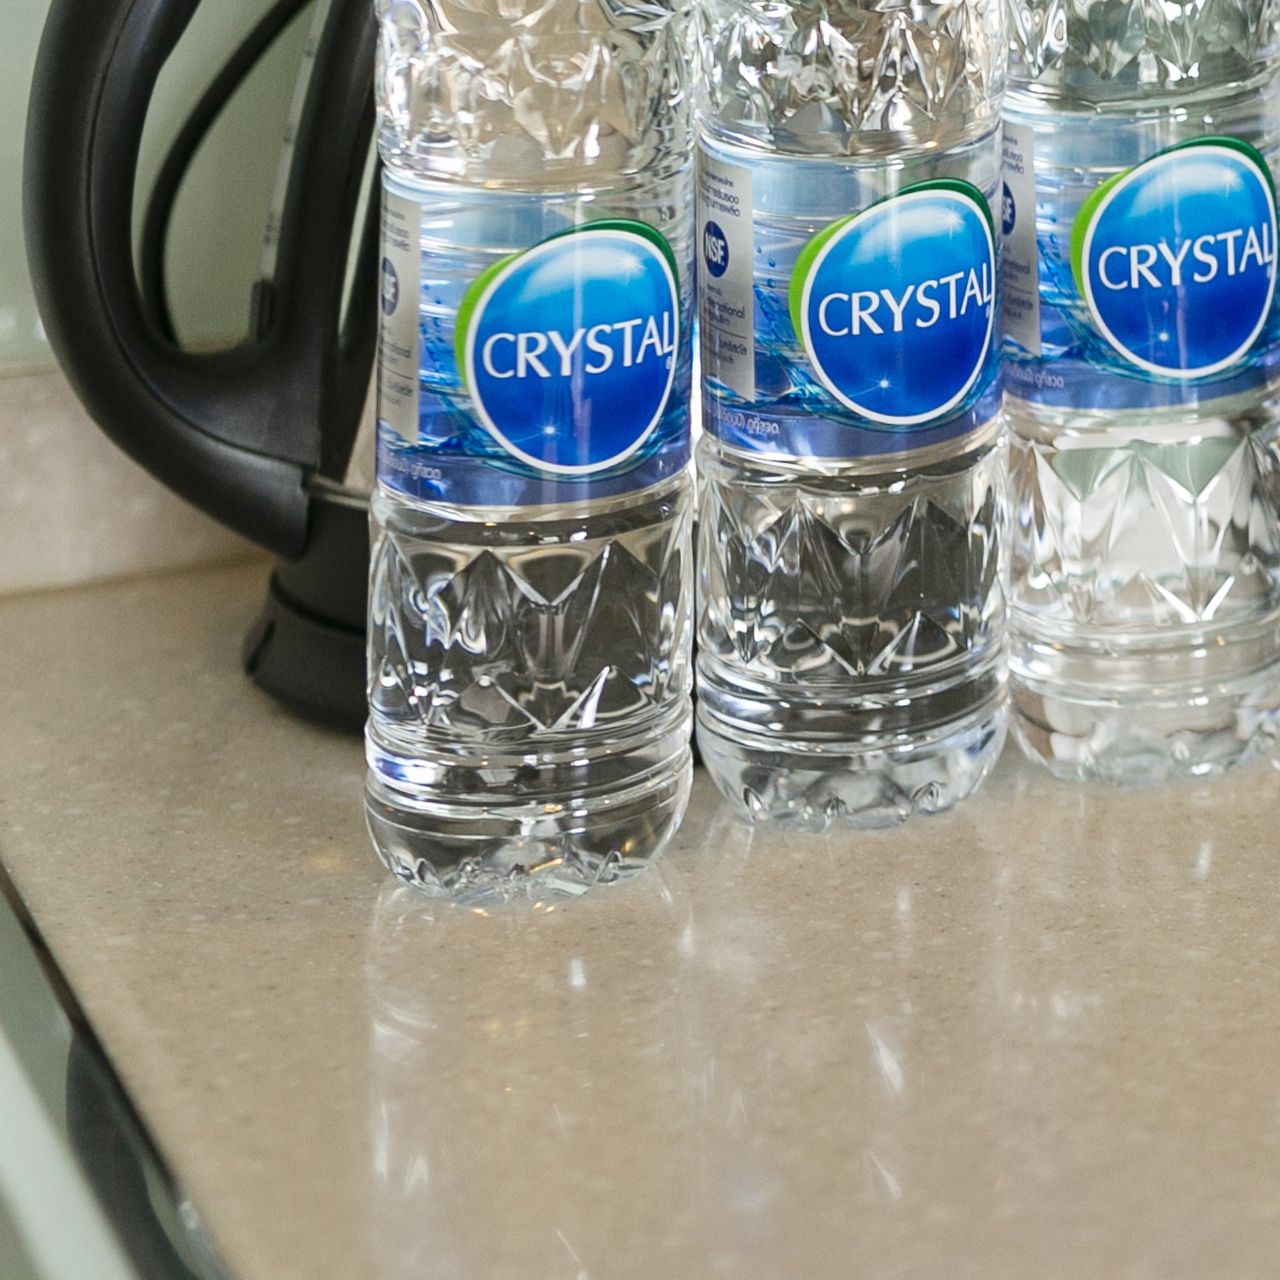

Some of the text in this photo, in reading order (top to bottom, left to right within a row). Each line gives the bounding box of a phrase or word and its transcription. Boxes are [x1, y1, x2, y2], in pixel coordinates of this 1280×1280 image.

[705, 232, 725, 265] NSF
[1097, 220, 1274, 291] CRYSTAL
[817, 261, 994, 337] CRYSTAL
[481, 310, 674, 380] CRYSTAL
